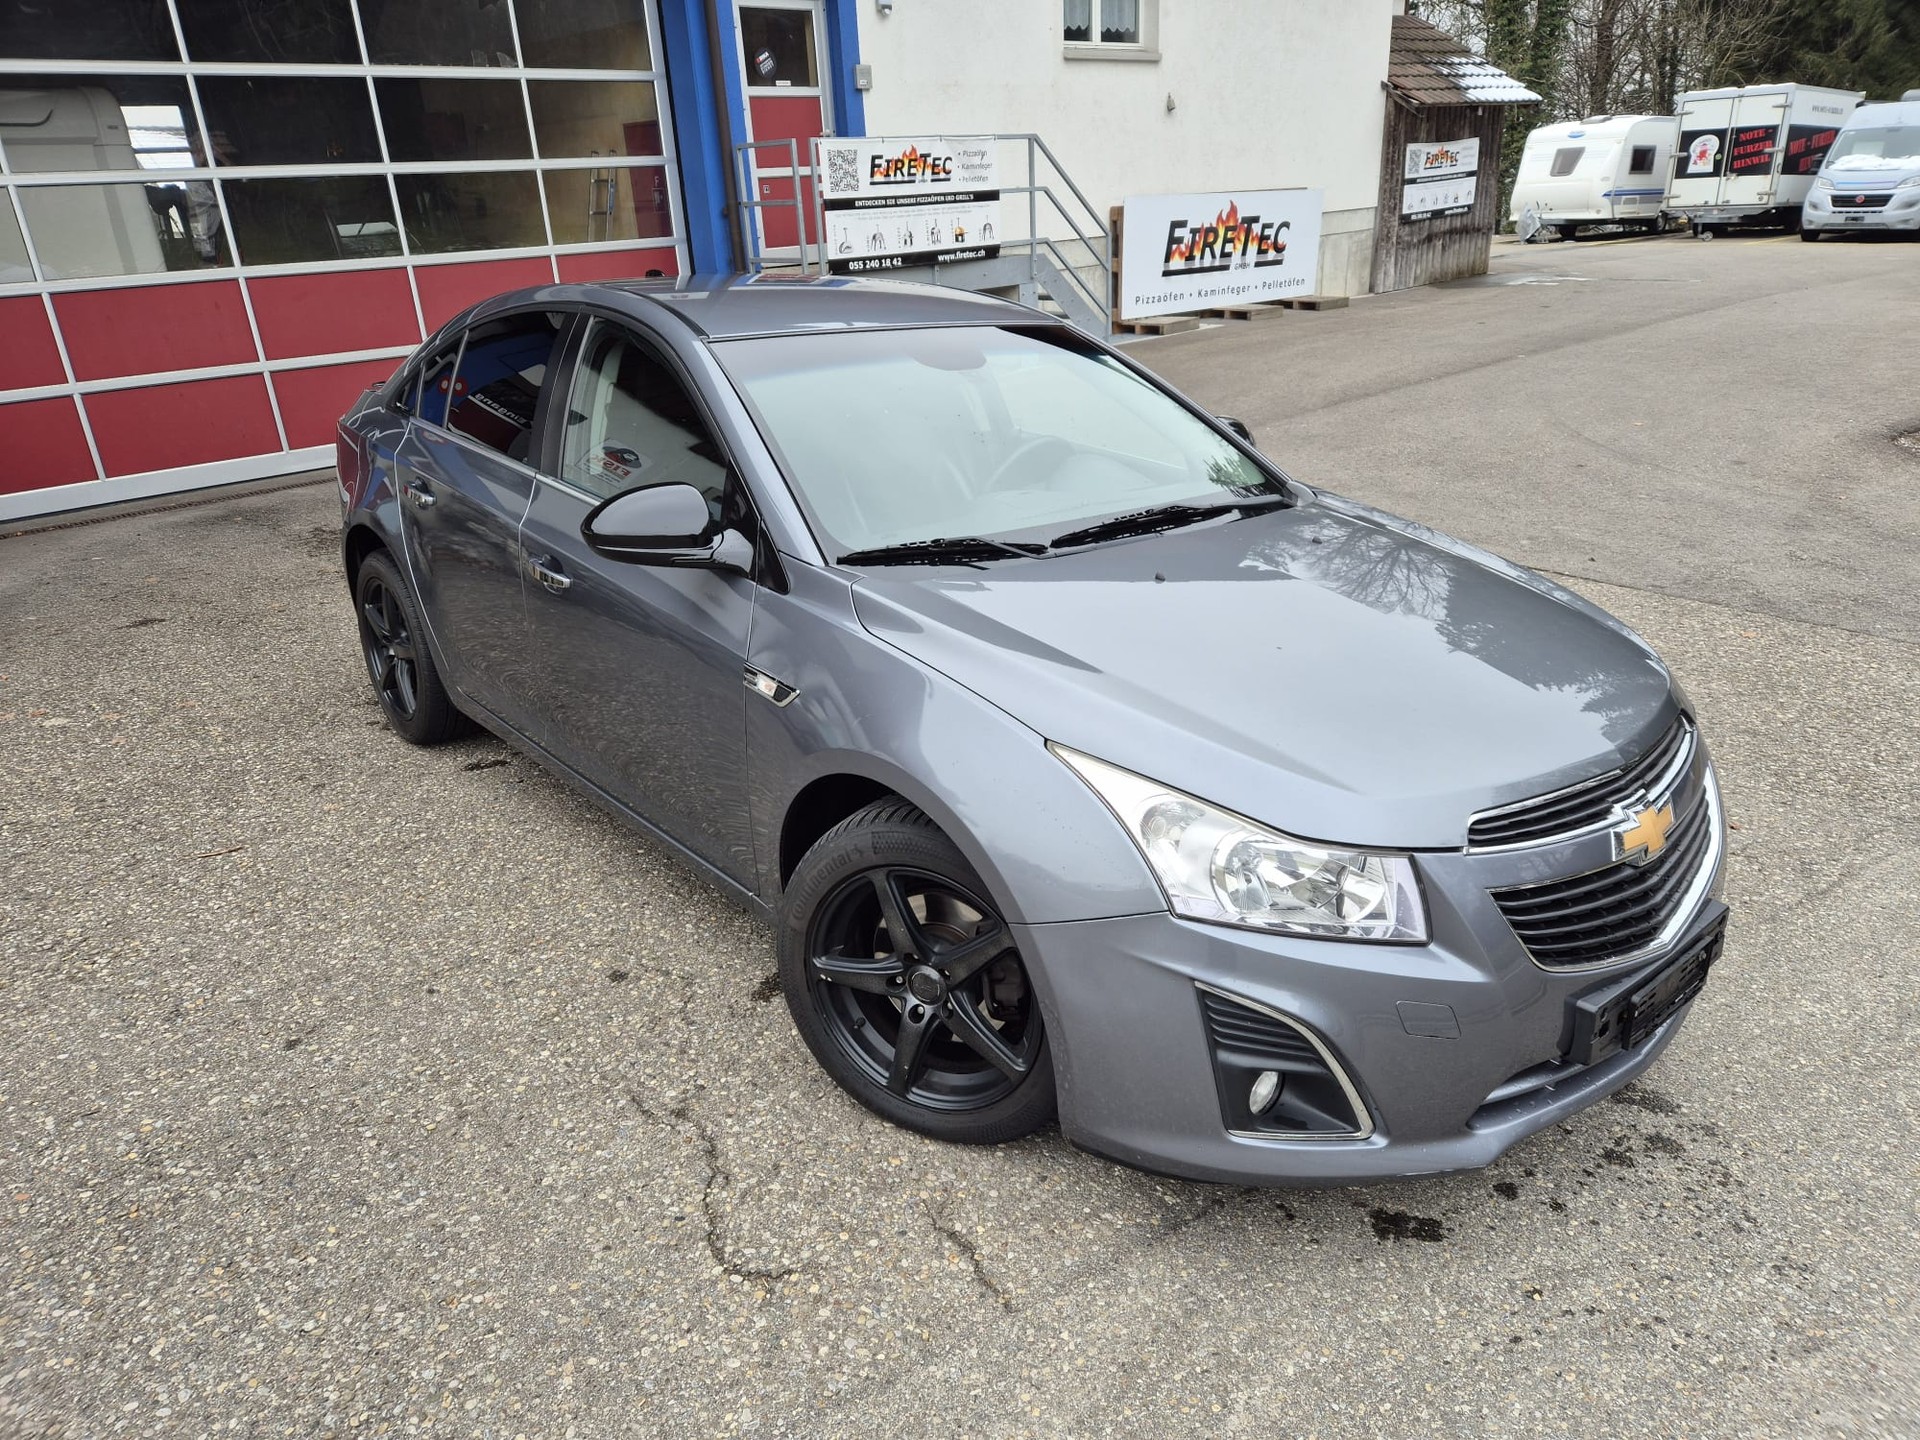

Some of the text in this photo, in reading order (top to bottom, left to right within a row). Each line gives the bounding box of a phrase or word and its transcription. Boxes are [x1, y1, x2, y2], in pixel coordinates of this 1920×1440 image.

[1739, 129, 1765, 141] NOTE
[1733, 140, 1773, 156] FURZER
[870, 153, 953, 178] FIRETEC
[1733, 154, 1771, 169] HINWIL
[1164, 216, 1291, 263] FIRETEC
[937, 249, 986, 261] www.firetec.ch
[848, 257, 902, 270] 055 240 18 42
[1135, 277, 1306, 306] Pizzaöfen Kaminfeger Pelletöfen
[791, 848, 853, 921] Continental
